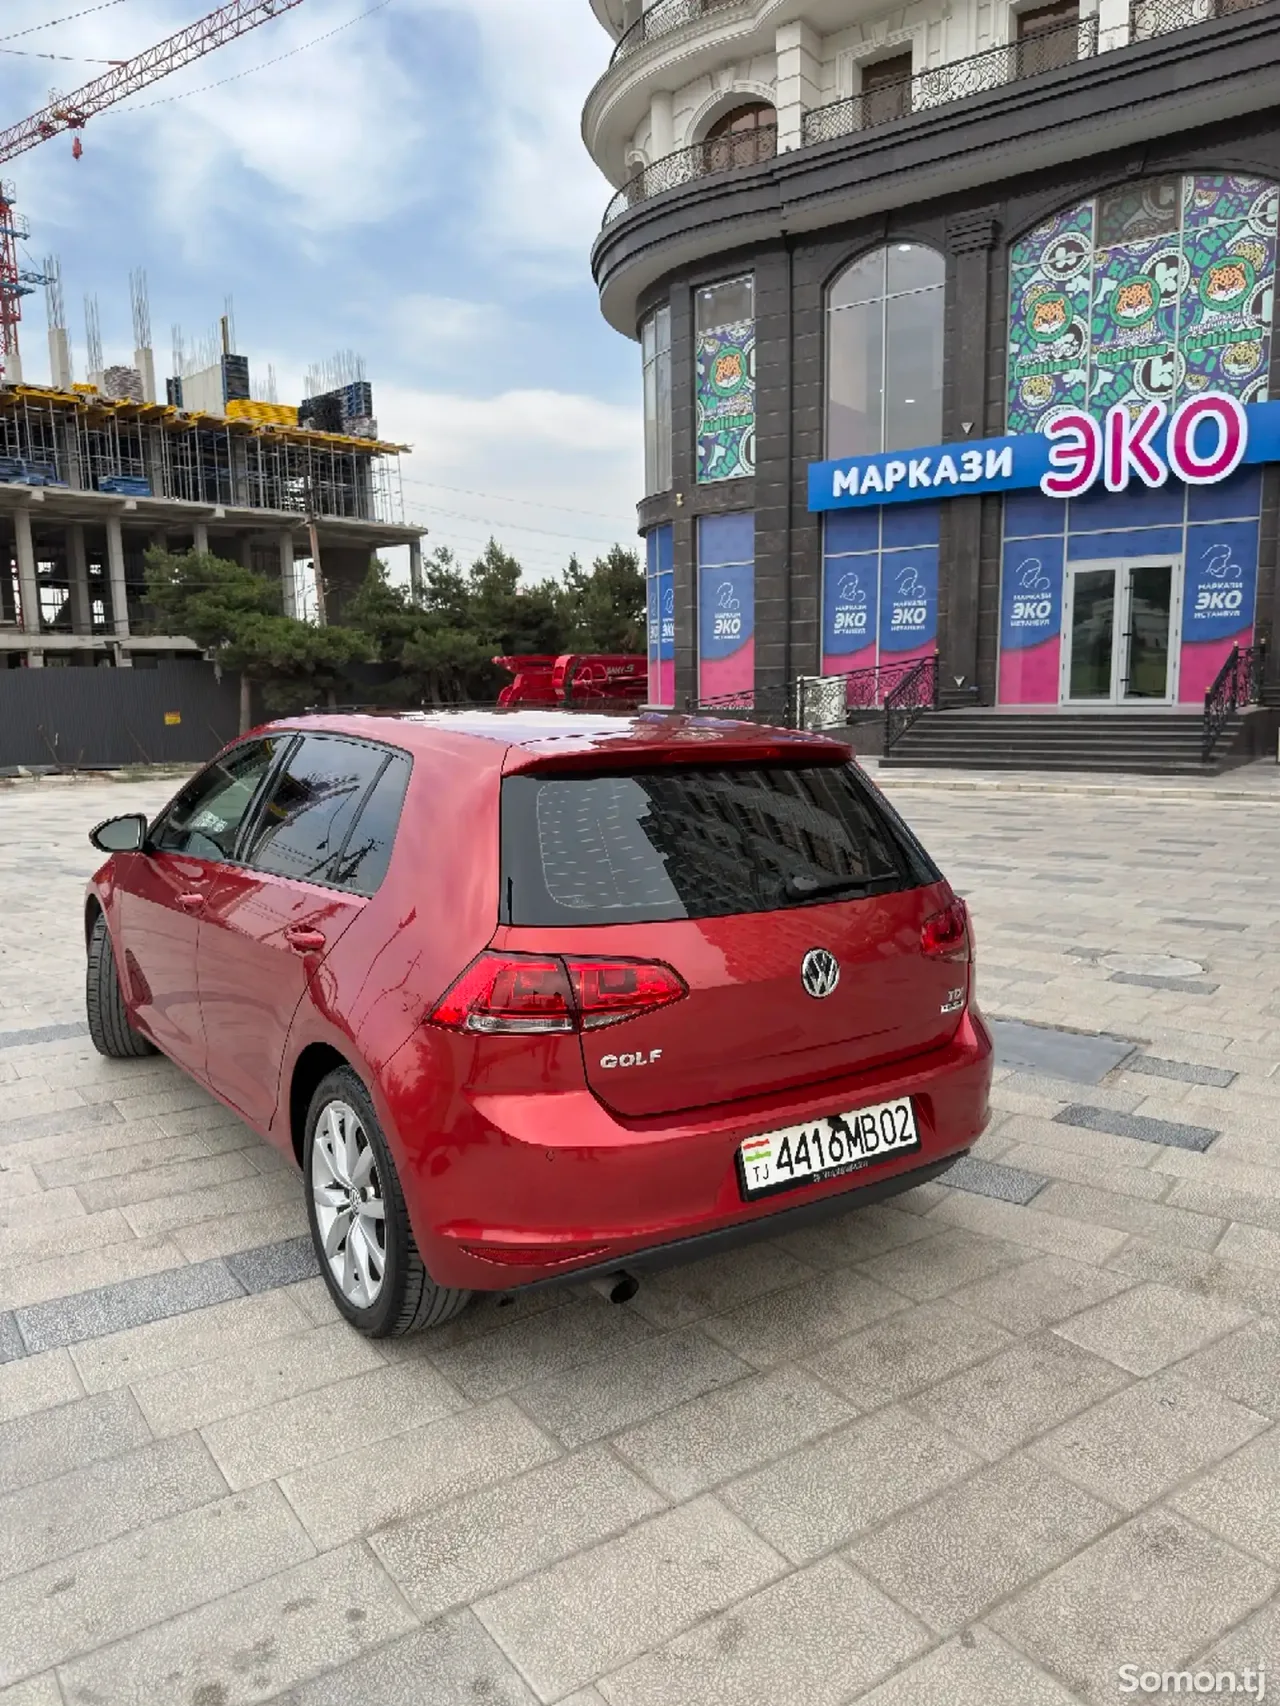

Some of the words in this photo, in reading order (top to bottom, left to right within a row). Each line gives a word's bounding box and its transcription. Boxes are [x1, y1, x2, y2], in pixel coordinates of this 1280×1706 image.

[832, 446, 1013, 498] МАРКАЗИ
[1040, 391, 1248, 498] ЭКО
[1194, 590, 1242, 610] ЭКО
[891, 607, 927, 625] ЭКО
[1010, 600, 1051, 619] ЭКО
[713, 618, 741, 635] ЭКО
[834, 612, 867, 629] ЭКО
[600, 1048, 662, 1069] GOLF
[753, 1165, 770, 1183] TJ
